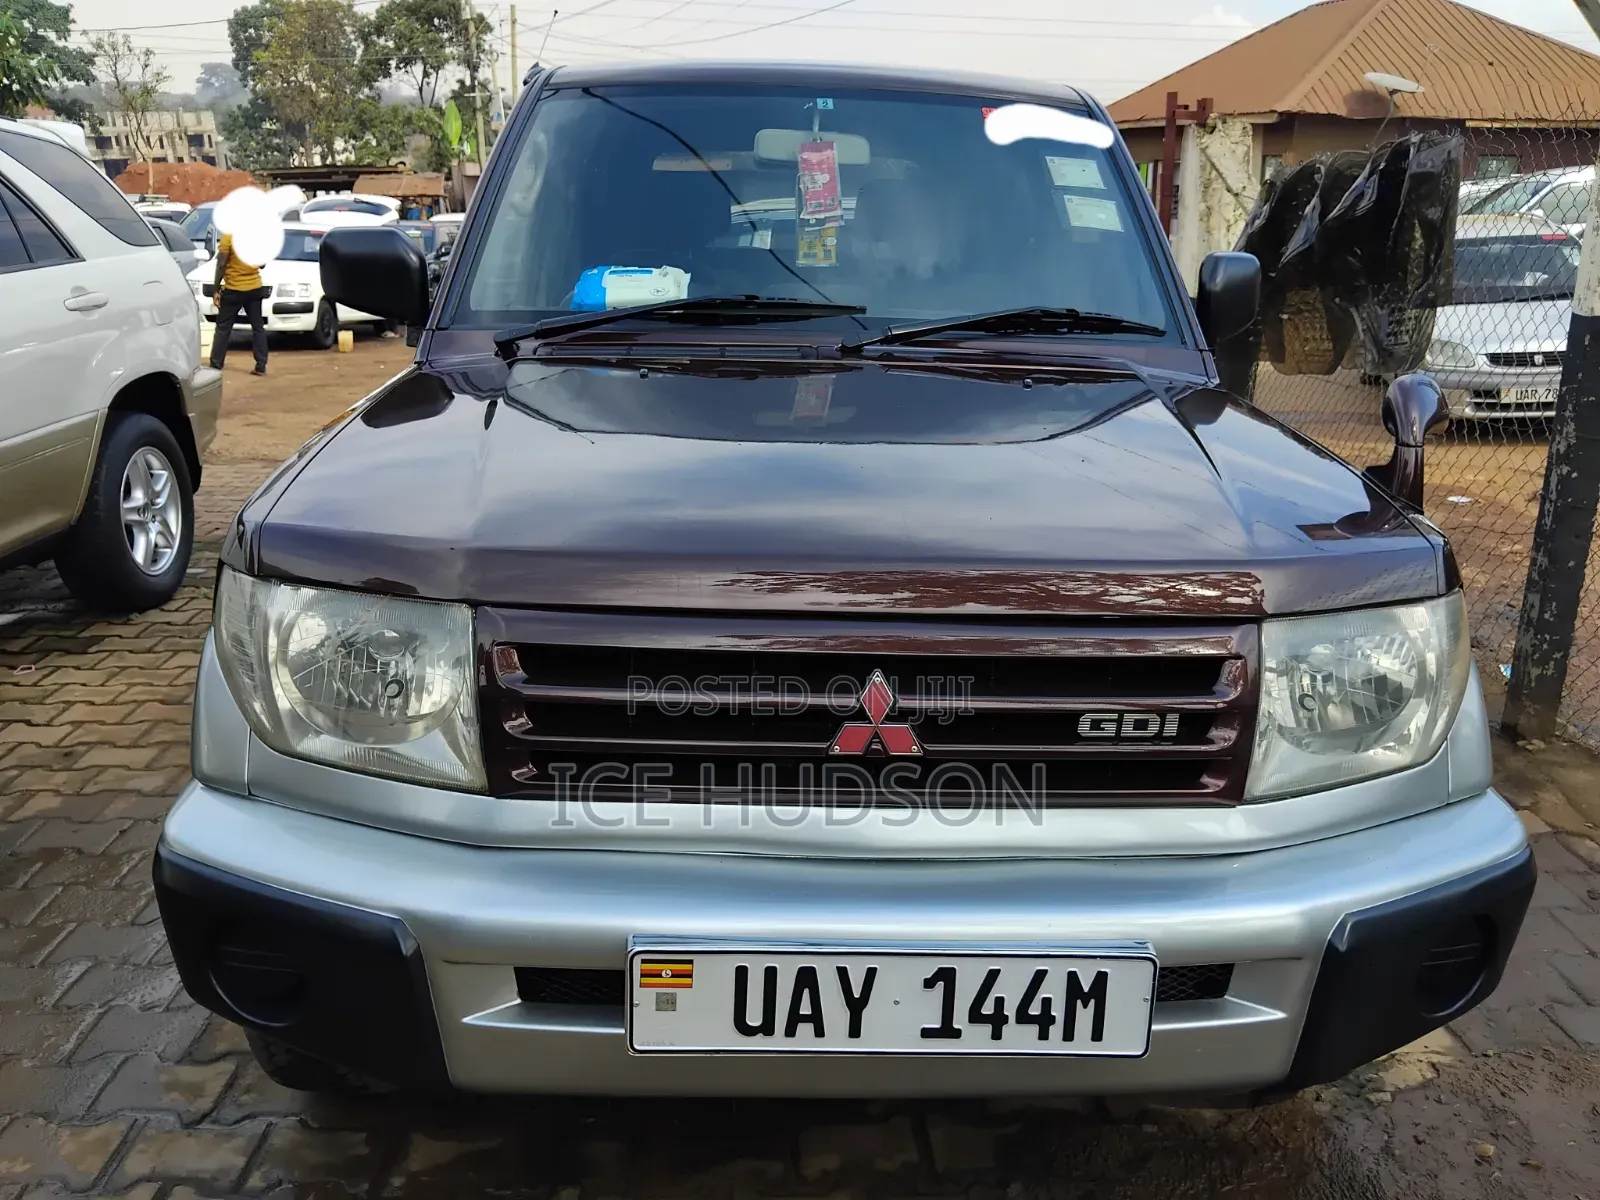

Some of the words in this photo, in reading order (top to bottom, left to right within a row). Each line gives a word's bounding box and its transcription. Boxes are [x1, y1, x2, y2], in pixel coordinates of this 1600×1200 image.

[1515, 389, 1538, 400] UAR
[1077, 713, 1179, 737] GDI
[733, 964, 878, 1040] UAY
[920, 965, 1109, 1043] 144M
